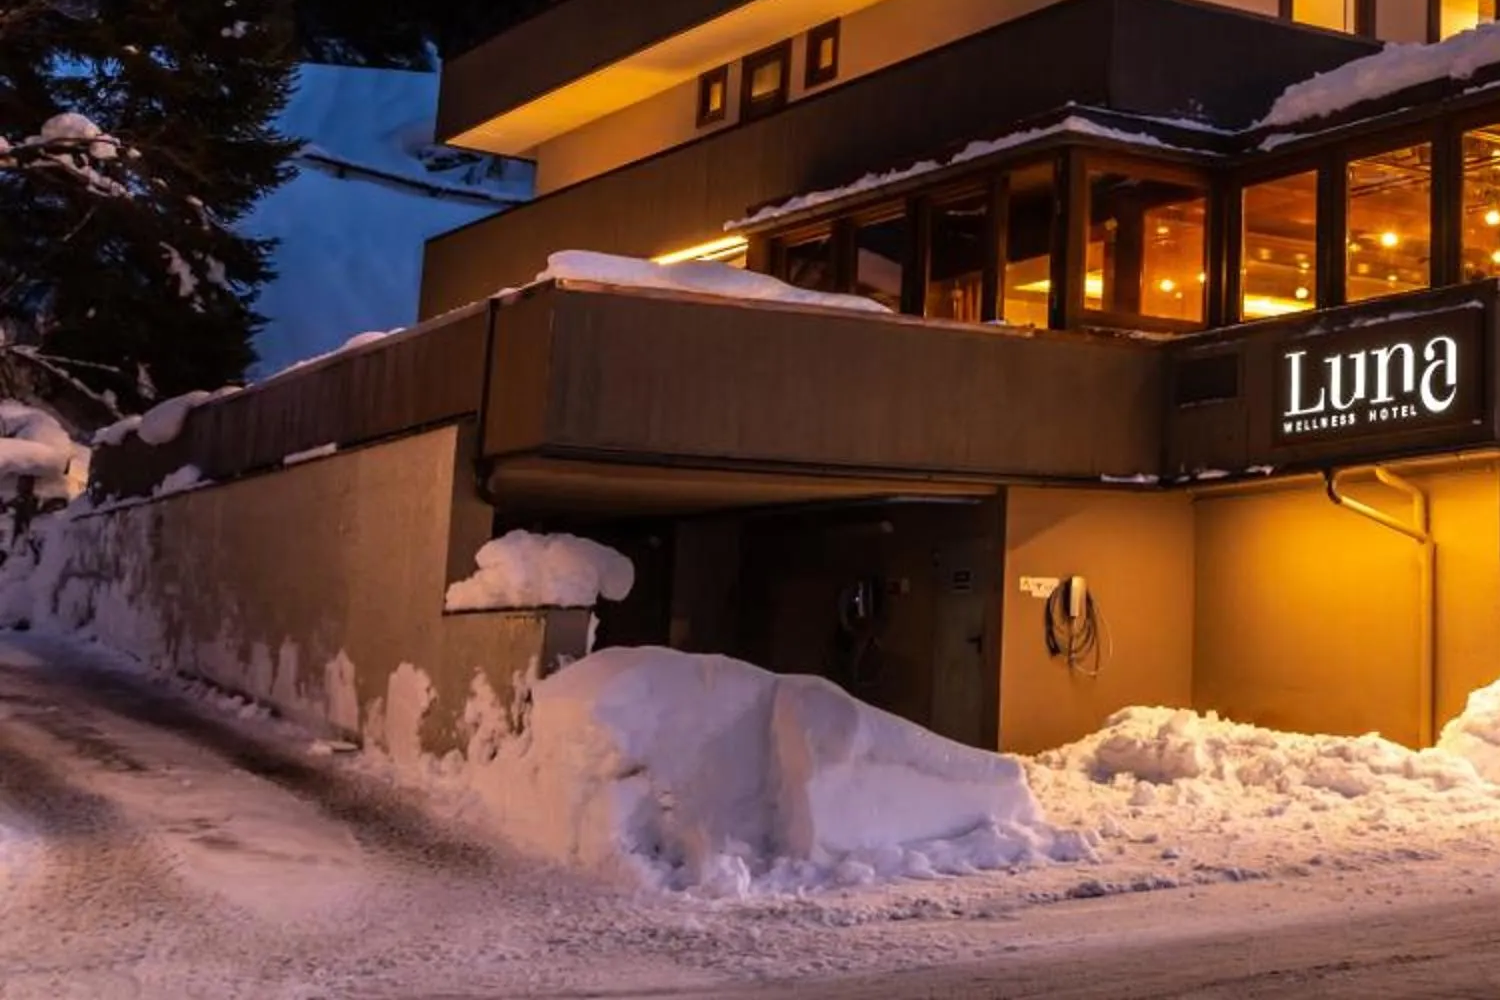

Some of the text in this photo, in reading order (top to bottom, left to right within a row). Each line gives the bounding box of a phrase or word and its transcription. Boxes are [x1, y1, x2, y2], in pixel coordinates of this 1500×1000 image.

[1284, 335, 1457, 417] Luna
[1283, 404, 1418, 433] WELLNESS HOTEL
